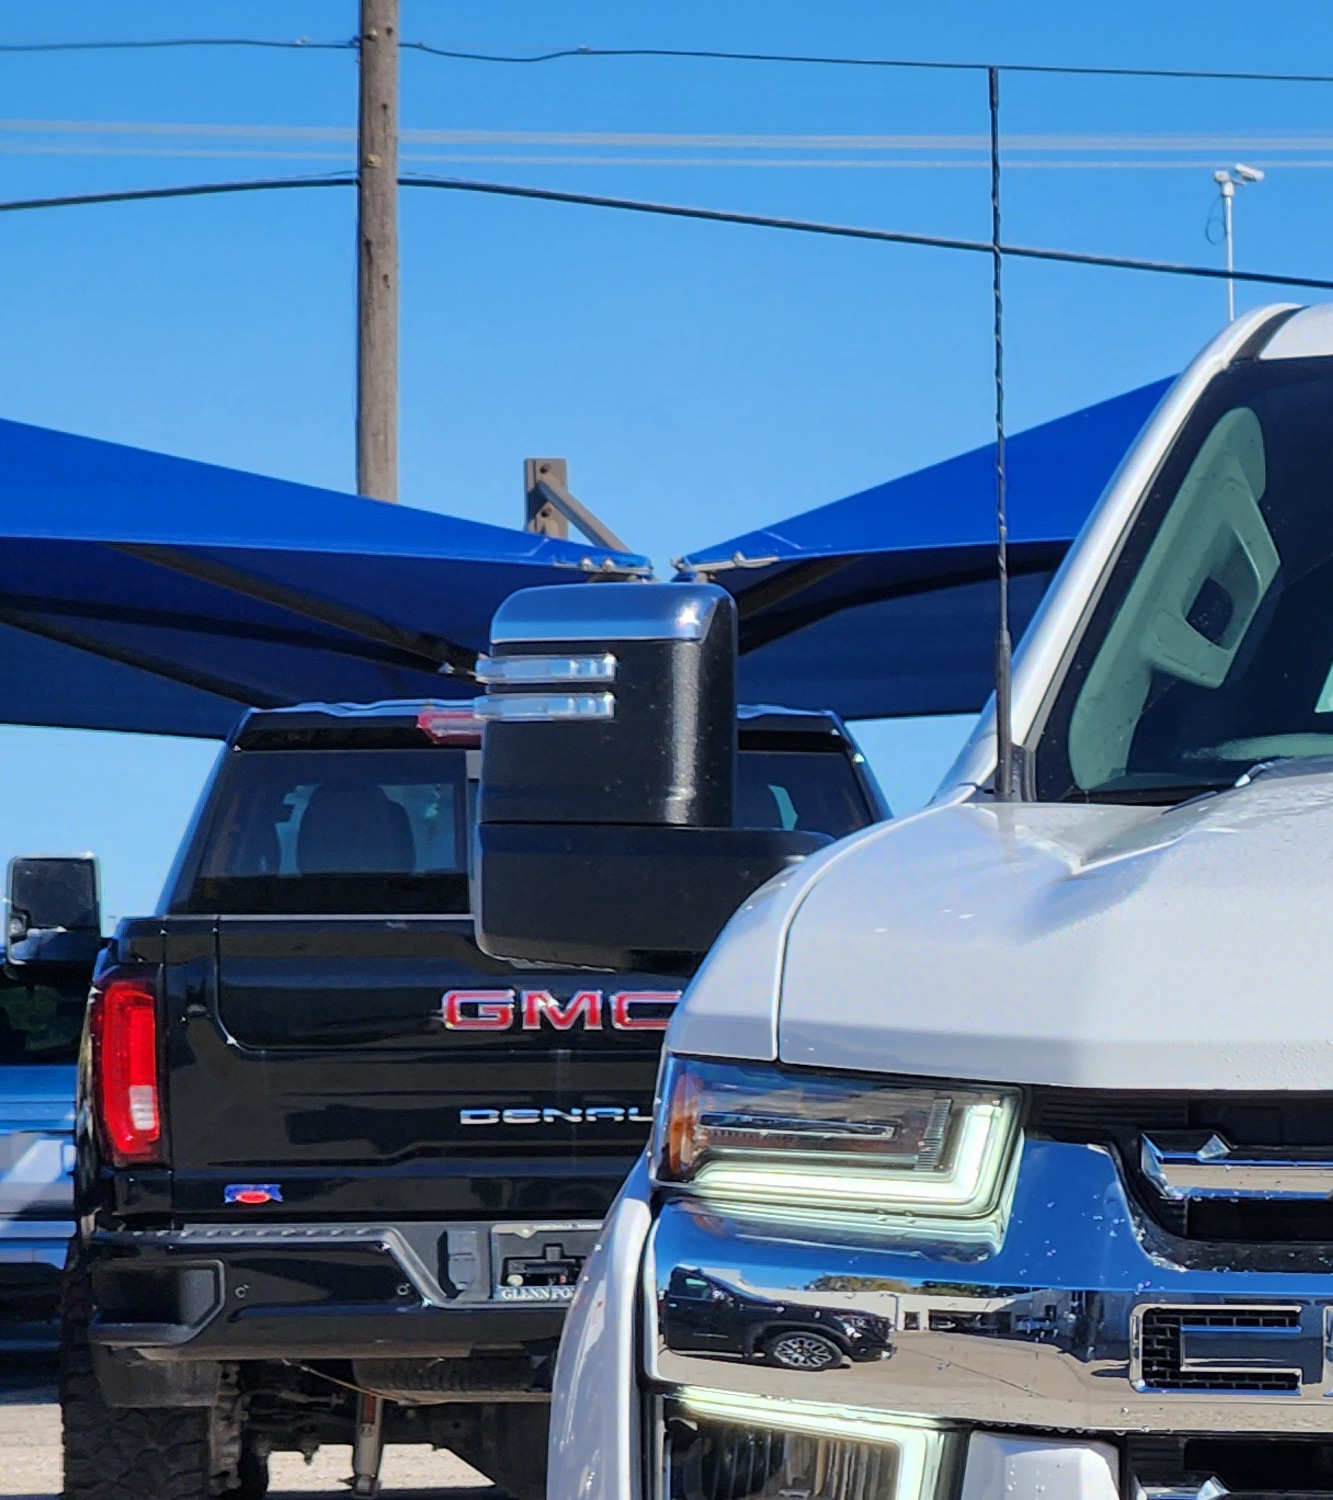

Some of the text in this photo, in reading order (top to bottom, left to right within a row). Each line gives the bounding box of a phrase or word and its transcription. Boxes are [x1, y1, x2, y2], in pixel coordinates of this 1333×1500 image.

[442, 989, 682, 1030] GMC
[460, 1106, 655, 1125] DENAL
[551, 1286, 575, 1299] PO
